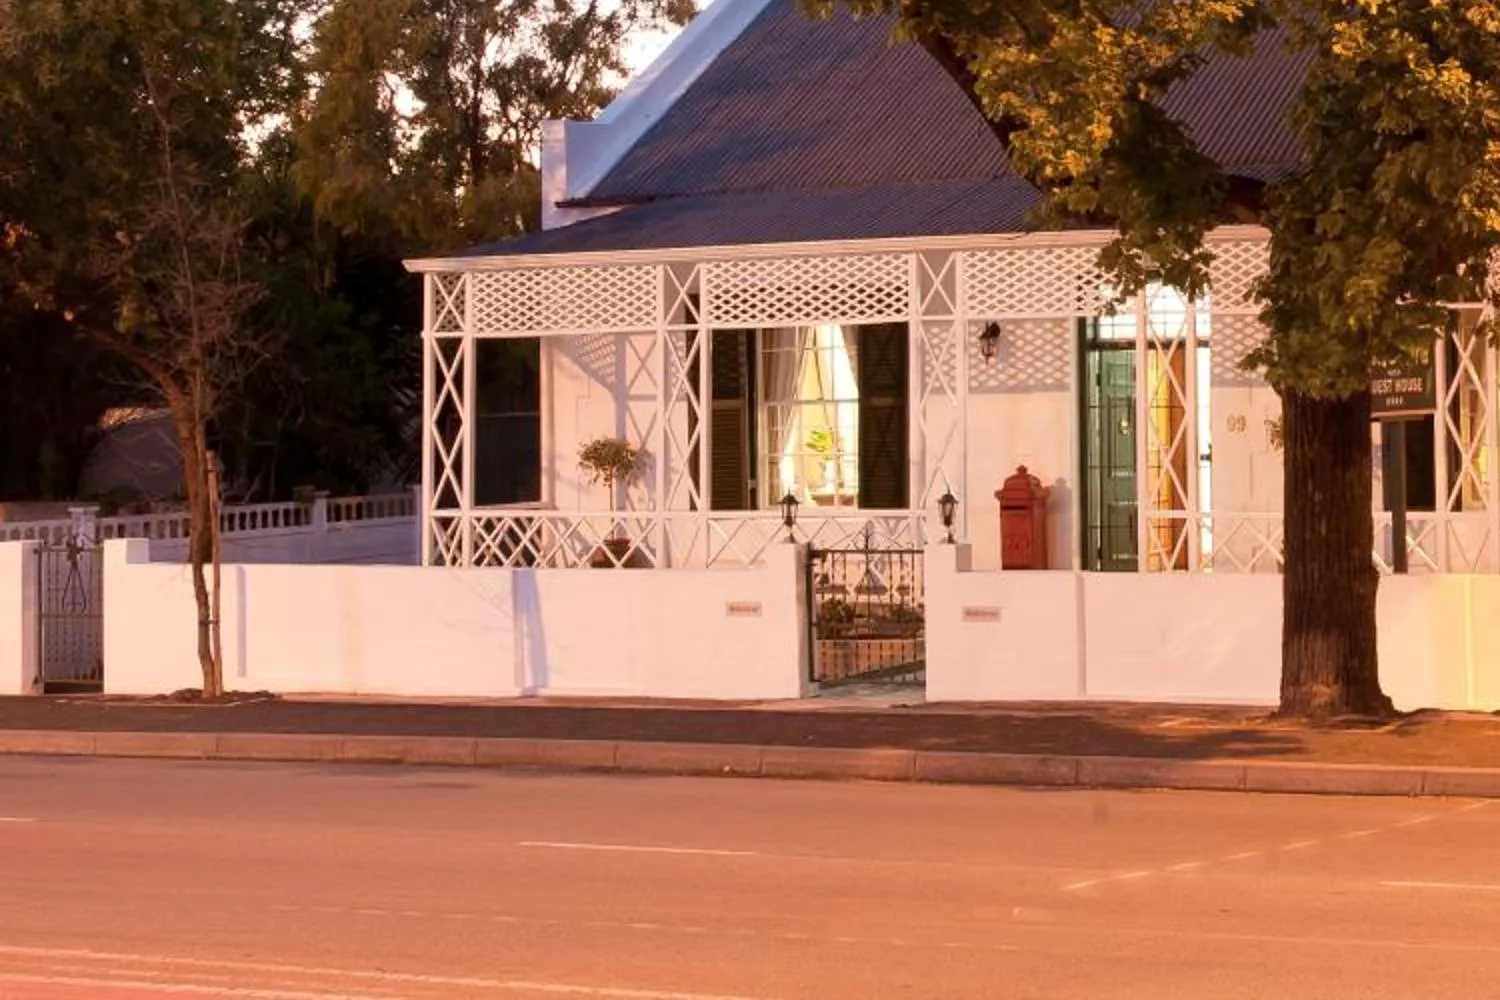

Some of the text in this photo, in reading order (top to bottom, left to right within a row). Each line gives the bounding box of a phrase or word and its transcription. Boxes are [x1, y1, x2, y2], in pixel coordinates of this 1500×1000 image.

[1370, 377, 1423, 394] UEST HOUSE
[1226, 414, 1246, 432] 99
